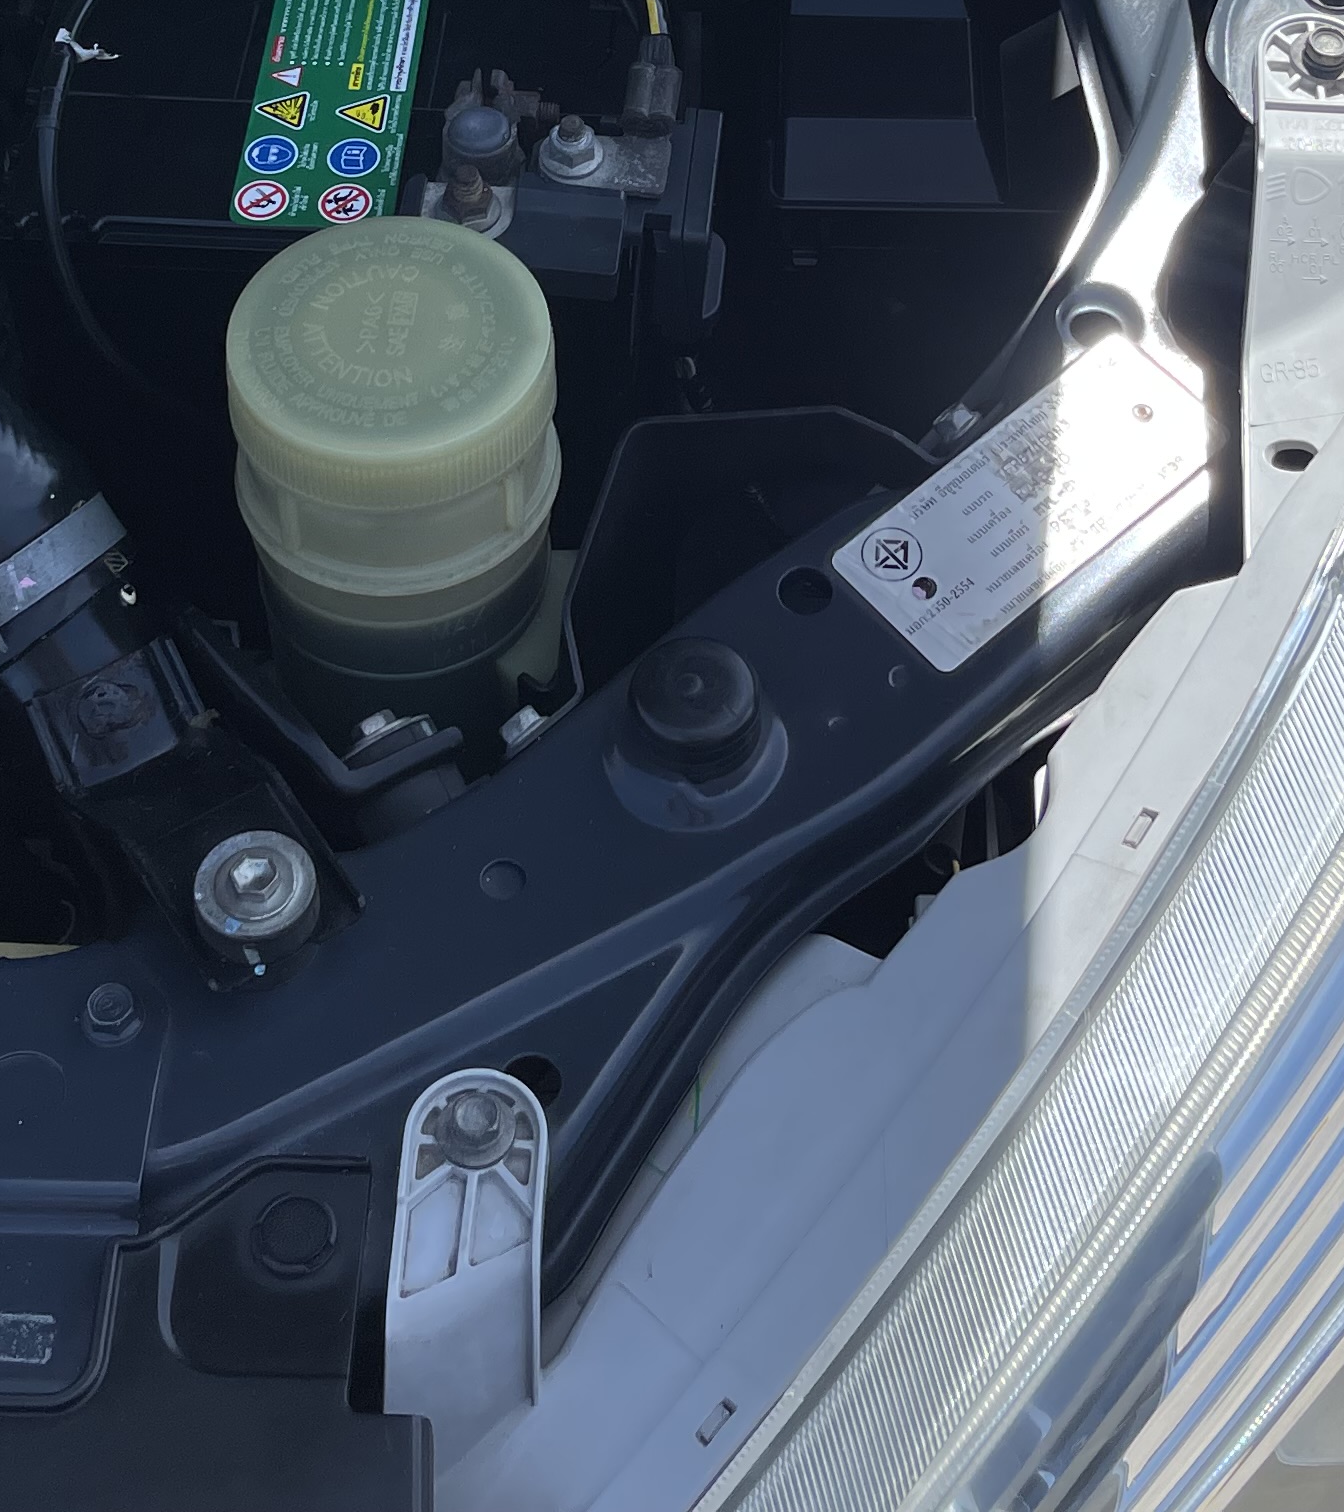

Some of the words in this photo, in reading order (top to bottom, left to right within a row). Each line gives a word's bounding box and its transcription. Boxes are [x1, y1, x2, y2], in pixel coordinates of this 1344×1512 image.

[310, 264, 420, 311] CAUTION
[302, 321, 413, 388] ATTENTION
[1259, 357, 1319, 384] GR-85
[961, 488, 994, 517] แบบรถ
